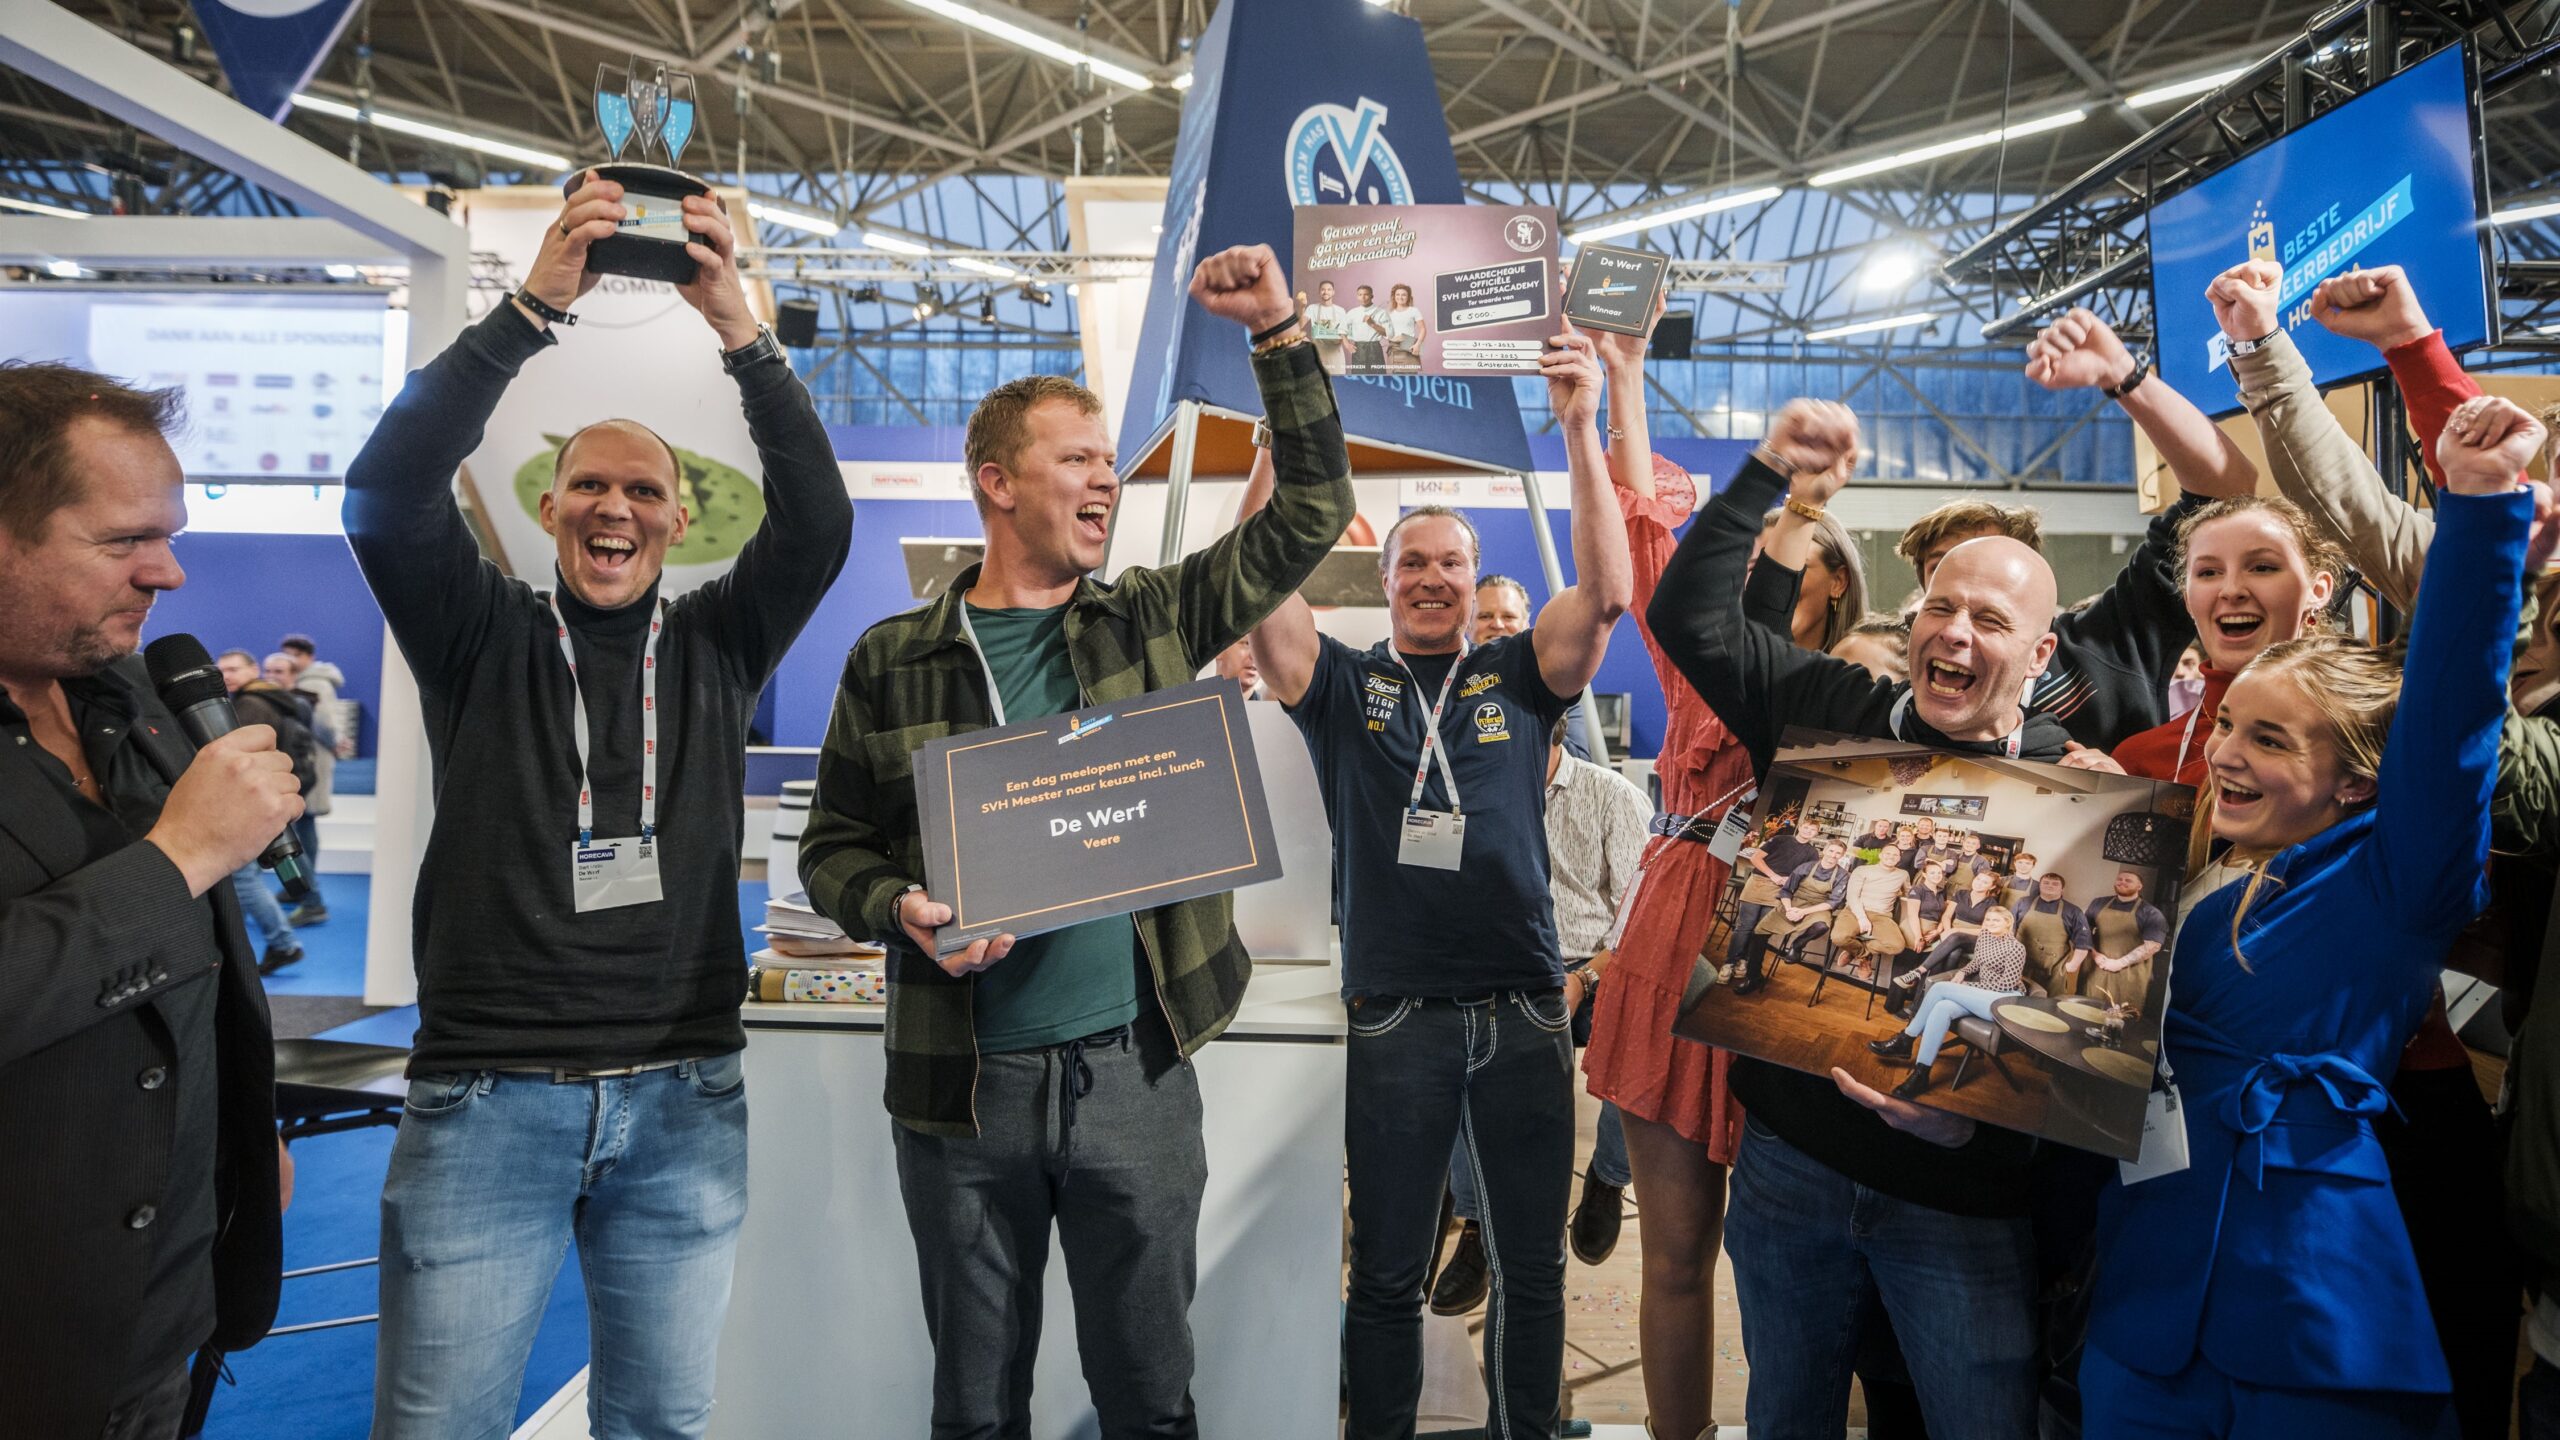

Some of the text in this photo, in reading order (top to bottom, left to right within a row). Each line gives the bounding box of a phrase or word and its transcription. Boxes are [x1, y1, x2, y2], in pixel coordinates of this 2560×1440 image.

[1323, 226, 1340, 241] Ga
[1342, 224, 1368, 236] voor
[2284, 201, 2341, 264] BESTE
[1316, 231, 1416, 257] ga voor een eigen
[2279, 192, 2399, 304] EERBEDRIJF
[1310, 242, 1414, 269] bedrijfsacademy!
[1600, 257, 1642, 272] De Werf
[1455, 265, 1526, 283] WAARDECHEQUE
[1470, 275, 1511, 289] OFFICIËLE
[1441, 280, 1540, 302] SVH BEDRIJFSACADEMY
[1589, 304, 1622, 317] Winnaar
[1367, 693, 1395, 709] HIGH
[1366, 706, 1392, 720] GEAR
[1368, 720, 1385, 732] NO.1
[1006, 750, 1176, 793] Een dag meelopen met een
[981, 758, 1205, 814] SVH Meester naar keuze incl. lunch
[1050, 799, 1147, 837] De Werf
[1083, 835, 1121, 849] Veere
[579, 851, 614, 860] HORECAVA
